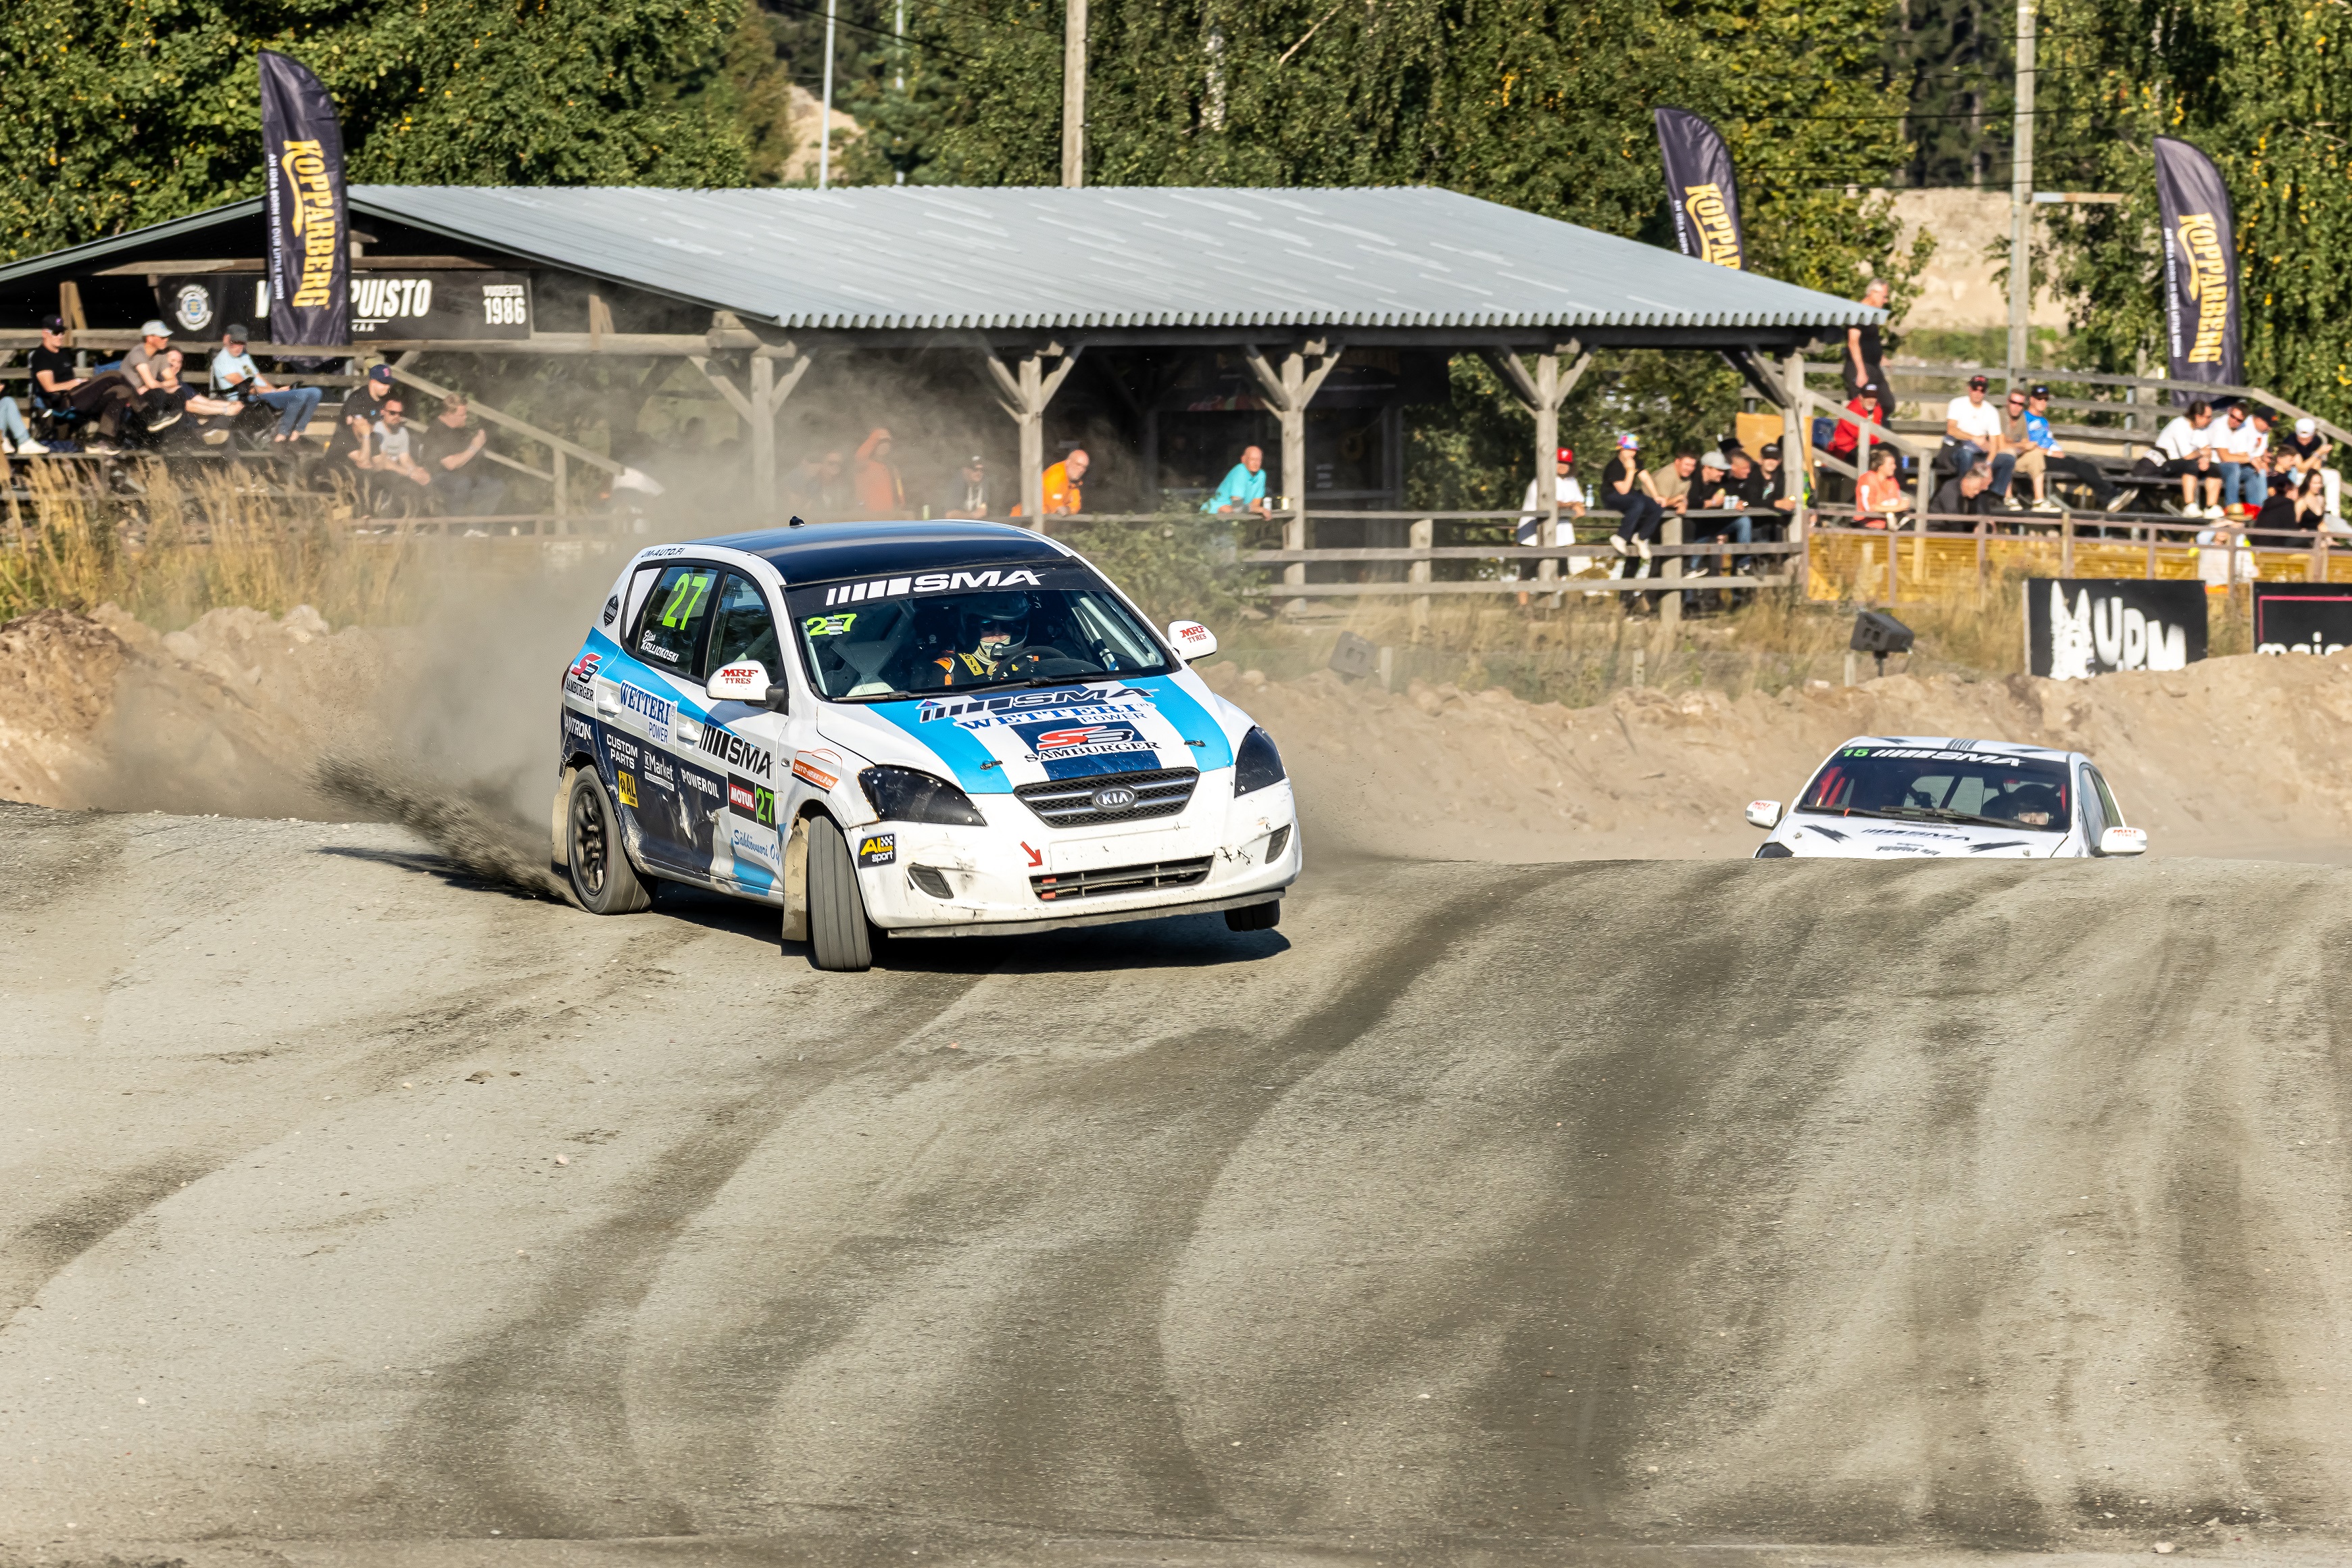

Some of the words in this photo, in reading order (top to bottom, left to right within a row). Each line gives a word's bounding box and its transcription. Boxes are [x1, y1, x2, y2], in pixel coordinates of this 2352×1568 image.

[281, 140, 335, 307] KOPPARBERG
[2177, 212, 2228, 363] KOPPARBERG
[483, 297, 526, 324] 1986
[641, 547, 685, 558] JM-AUTO.FI
[662, 573, 708, 631] 27
[806, 613, 857, 636] 27
[1179, 626, 1205, 638] MRF
[1187, 633, 1207, 643] TYRES
[720, 669, 758, 677] MRF
[620, 681, 671, 726] WETTERI
[959, 704, 1141, 730] WETTERI
[1081, 712, 1148, 723] POWER
[649, 721, 668, 744] POWER
[606, 733, 638, 758] CUSTOM
[1024, 741, 1162, 763] SAMBURGER
[1842, 748, 1870, 758] 15
[610, 748, 635, 770] PARTS
[681, 768, 720, 799] POWEROIL
[730, 786, 754, 809] MOTUL
[756, 787, 775, 824] 27
[1102, 793, 1129, 804] KIA
[860, 837, 893, 856] AL
[872, 850, 893, 863] sport
